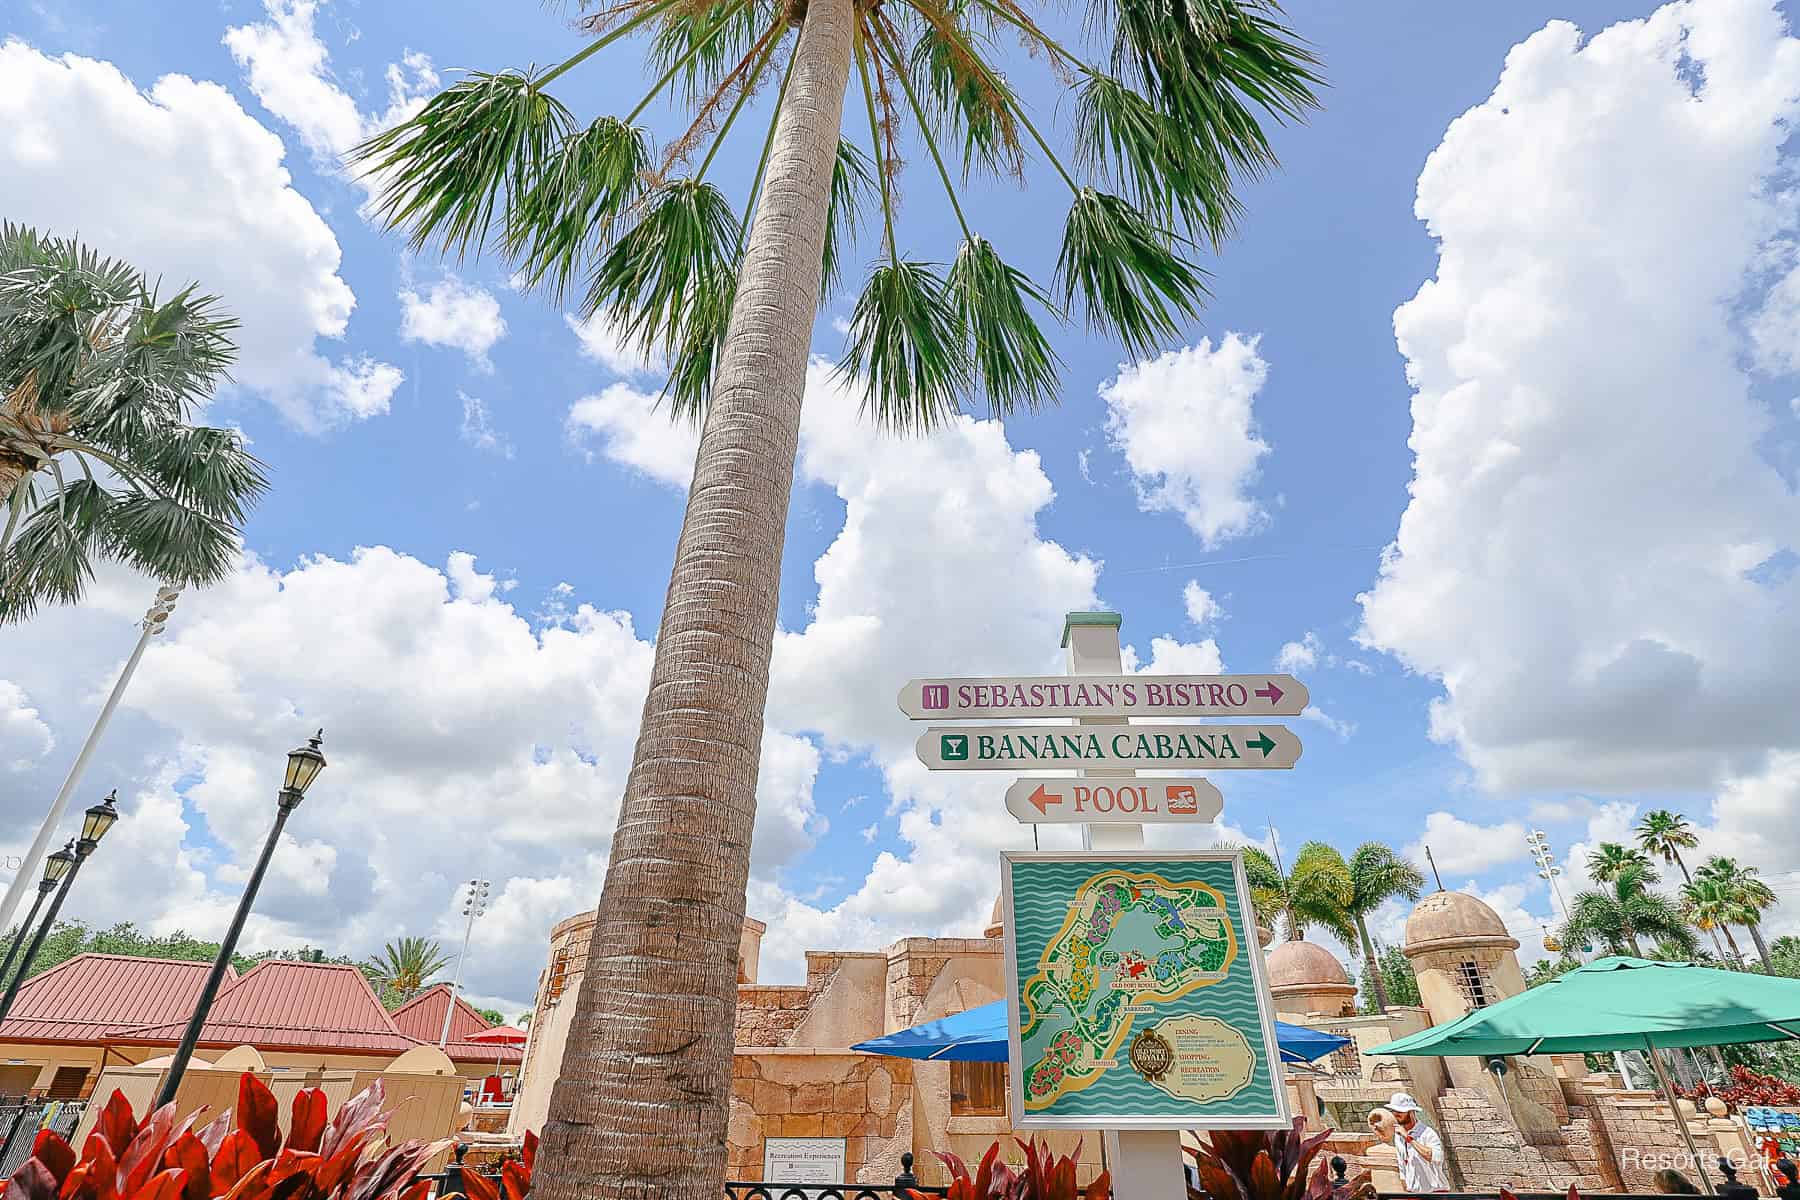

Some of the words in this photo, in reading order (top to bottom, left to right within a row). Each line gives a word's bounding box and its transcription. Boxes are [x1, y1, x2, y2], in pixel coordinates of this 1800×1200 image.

[957, 683, 1137, 709] SEBASTIAN'S
[1145, 683, 1249, 708] BISTRO
[977, 734, 1105, 760] BANANA
[1112, 732, 1241, 759] CABANA
[1073, 786, 1158, 813] POOL
[804, 1152, 841, 1160] Experiences
